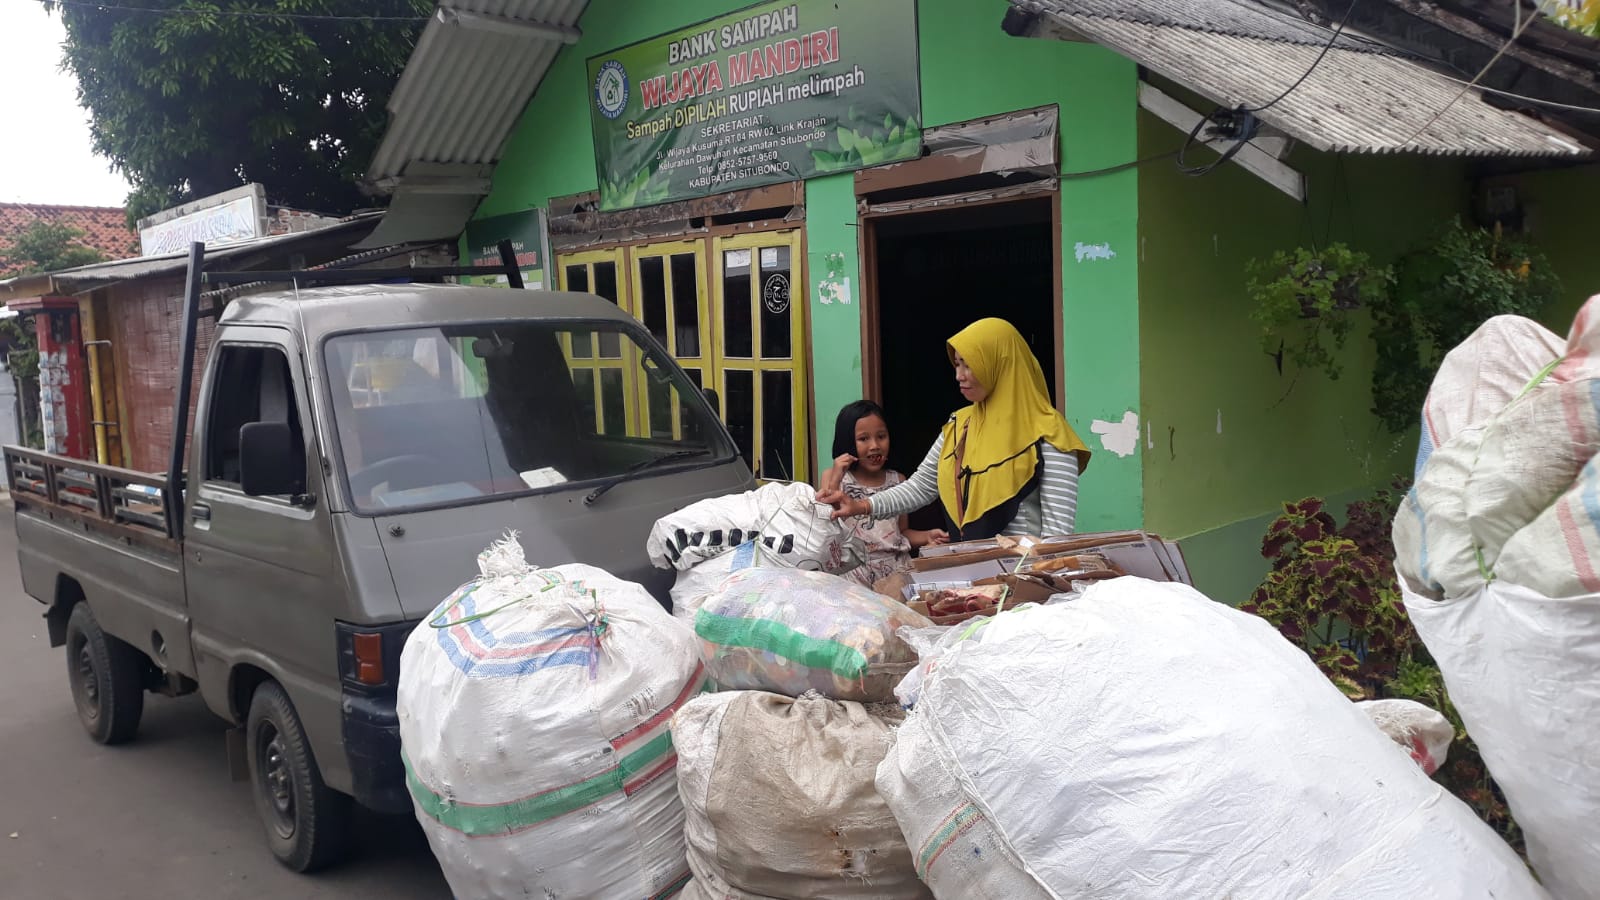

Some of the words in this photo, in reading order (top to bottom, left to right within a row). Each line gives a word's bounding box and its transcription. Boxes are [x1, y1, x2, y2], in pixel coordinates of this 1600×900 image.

[669, 30, 717, 64] BANK
[721, 5, 798, 48] SAMPAH
[640, 60, 723, 110] WIJAYA
[728, 26, 840, 88] MANDIRI
[626, 112, 672, 139] Sampah
[674, 97, 727, 128] DIPILAH
[729, 82, 784, 114] RUPIAH
[787, 64, 865, 101] melimpah
[667, 146, 691, 159] Wijaya
[692, 137, 723, 152] Kusuma
[748, 126, 774, 140] RW.02
[776, 121, 795, 134] Link
[797, 116, 827, 130] Krajan
[701, 114, 764, 138] SEKRETARIAT
[658, 157, 695, 171] Kelurahan
[696, 148, 731, 163] Dawuhan
[733, 139, 779, 155] Kecamatan
[780, 130, 827, 146] Situbondo
[689, 170, 737, 188] KABUPATEN
[739, 161, 790, 179] SITUBONDO
